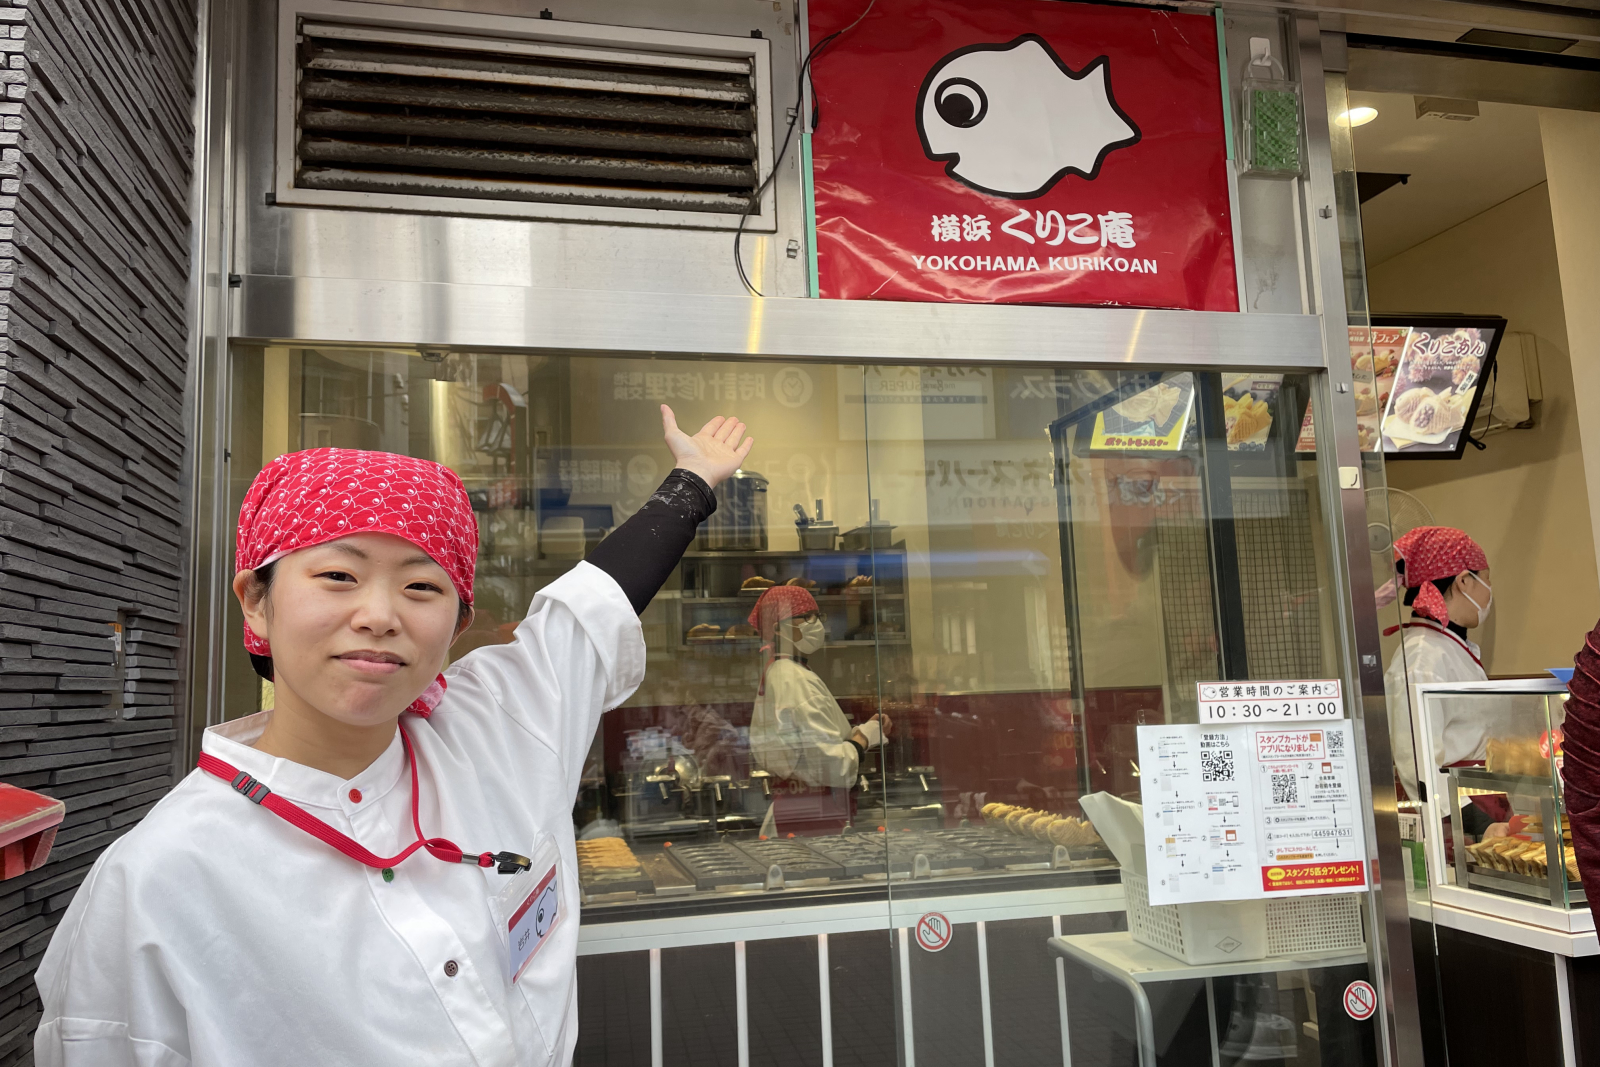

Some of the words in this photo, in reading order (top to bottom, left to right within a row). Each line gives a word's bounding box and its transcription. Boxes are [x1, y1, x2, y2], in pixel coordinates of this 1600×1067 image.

[931, 214, 991, 242] 横浜
[1001, 208, 1136, 249] くりこ庵
[911, 255, 1040, 271] YOKOHAMA
[1048, 256, 1158, 274] KURIKOAN
[1412, 332, 1487, 357] くりこあん
[1218, 684, 1322, 698] 営業時間のご案内
[1259, 734, 1309, 744] スタンプカードが
[1313, 829, 1351, 838] 445947631
